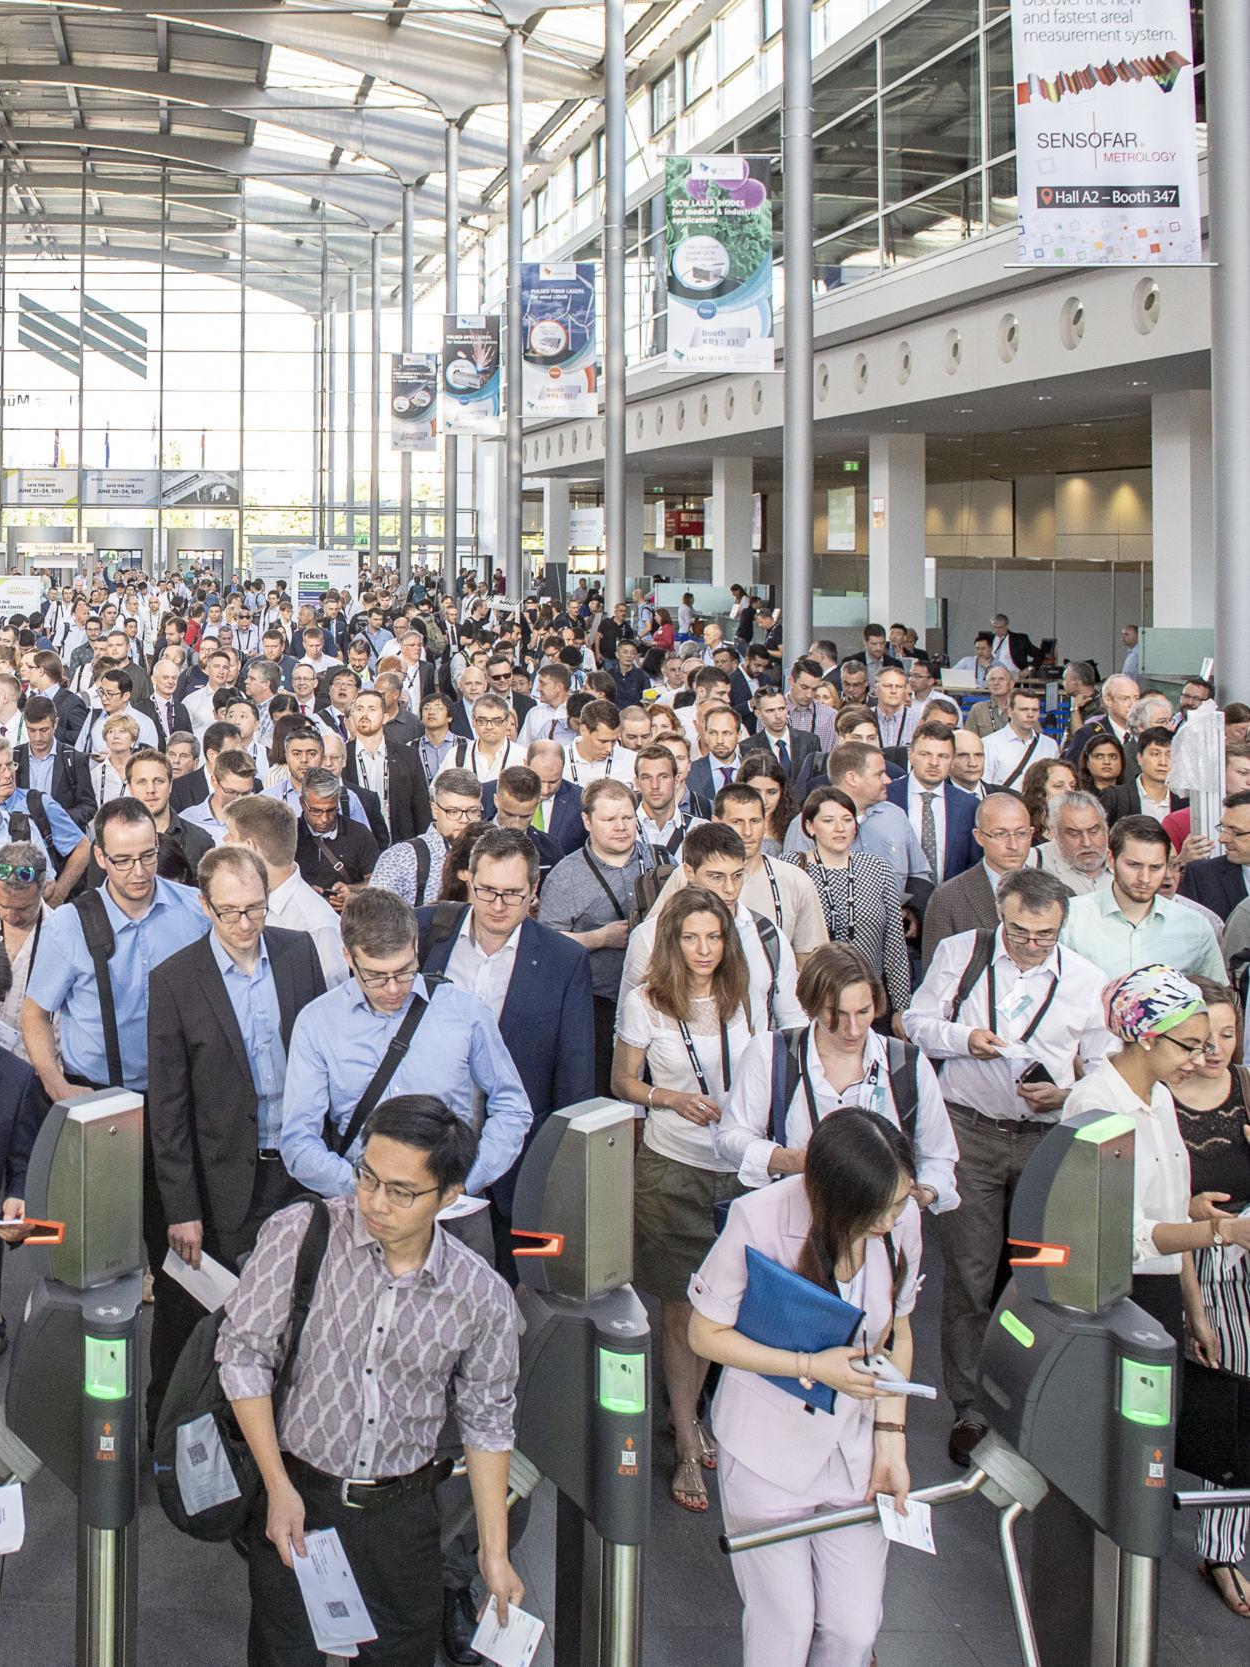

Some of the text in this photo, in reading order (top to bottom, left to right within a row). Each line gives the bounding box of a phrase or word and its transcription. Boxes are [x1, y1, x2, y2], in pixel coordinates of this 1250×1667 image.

[1022, 8, 1133, 24] and fastest areal
[1023, 28, 1178, 45] measurement system.
[1037, 132, 1138, 149] SENSOFAR
[1103, 152, 1177, 163] METROLOGY
[1055, 190, 1079, 203] Hall
[1082, 190, 1099, 203] A2
[1112, 189, 1150, 203] Booth
[1153, 189, 1177, 203] 347
[691, 200, 716, 208] LASER
[717, 200, 746, 208] DIODES
[672, 208, 683, 216] for
[685, 208, 715, 216] medical
[724, 208, 761, 216] industrial
[672, 216, 718, 225] applications
[96, 1450, 117, 1461] EXIT
[618, 1465, 638, 1476] EXIT
[1145, 1478, 1166, 1488] EXIT
